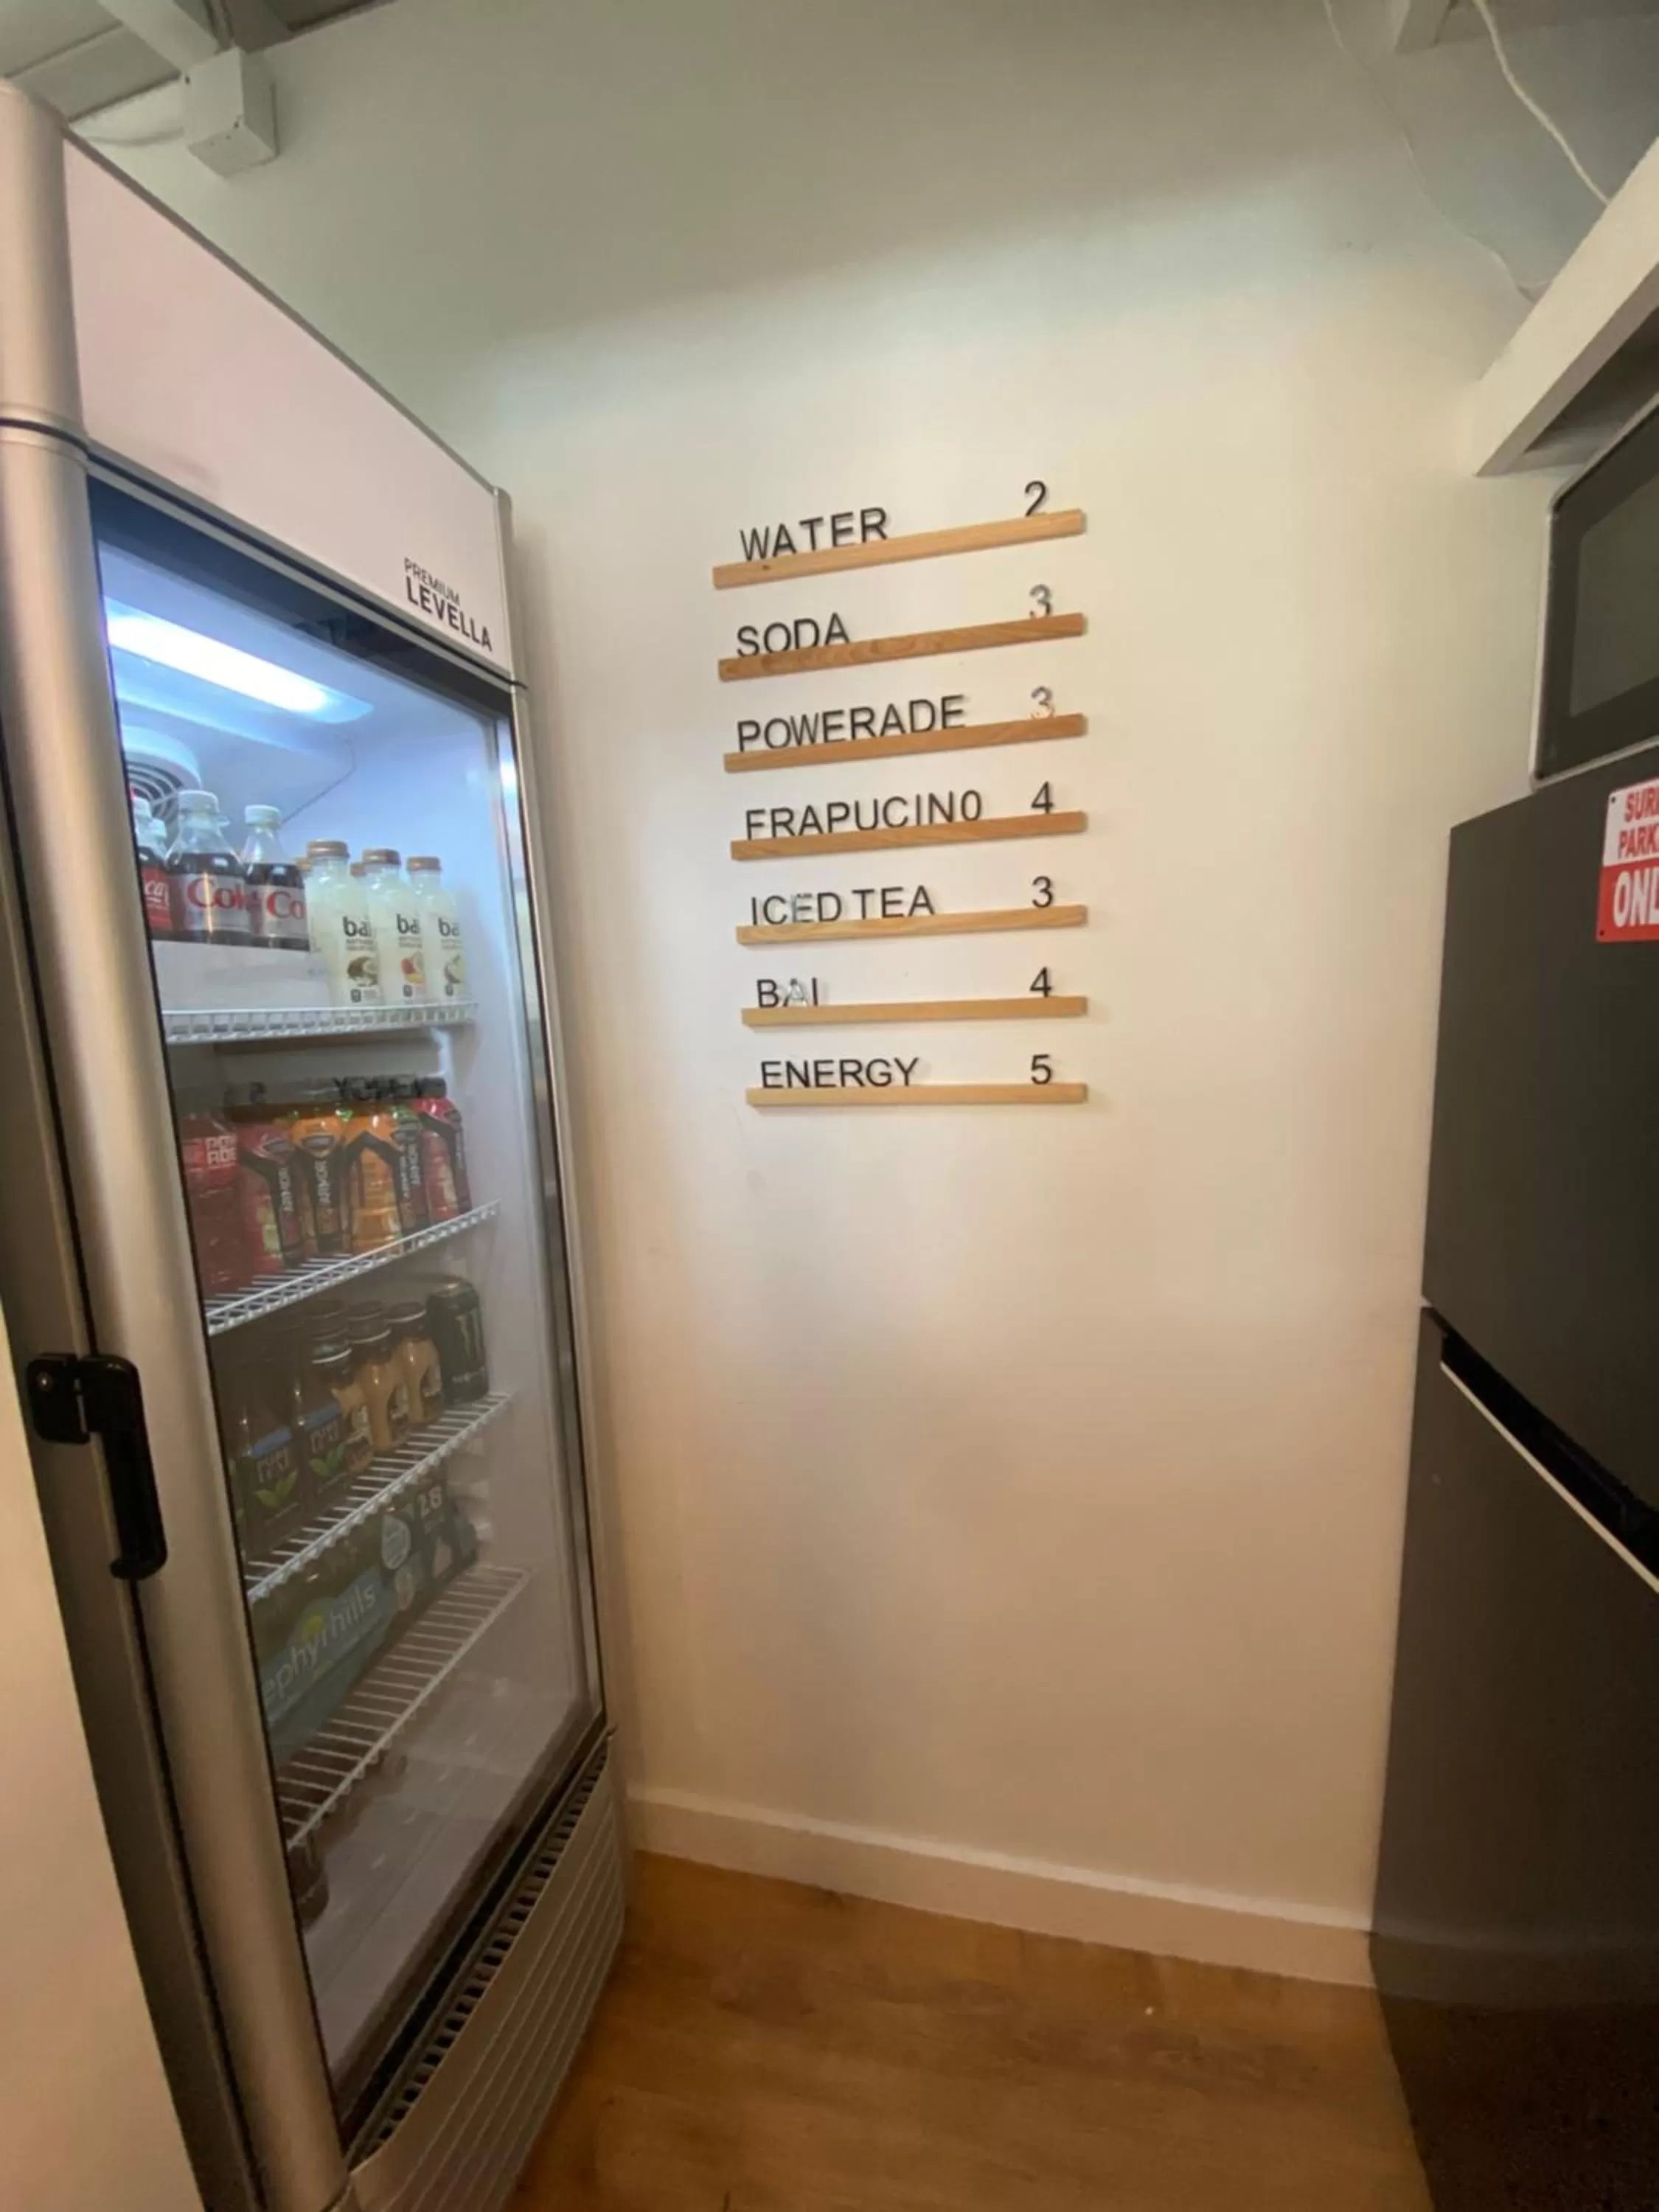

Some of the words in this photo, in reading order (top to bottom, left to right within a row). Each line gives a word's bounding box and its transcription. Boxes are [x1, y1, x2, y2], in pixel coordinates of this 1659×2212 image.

[740, 507, 888, 562] WATER
[1024, 481, 1047, 517] 2
[403, 557, 461, 607] PREMIUM
[406, 574, 493, 652] LEVELLA
[737, 613, 850, 658] SODA
[1029, 585, 1053, 618] 3
[737, 695, 966, 753] POWERADE
[1030, 686, 1055, 719] 3
[1031, 781, 1054, 814] 4
[1625, 787, 1659, 822] SUR
[751, 892, 842, 926] ICED
[852, 886, 936, 920] TEA
[1032, 876, 1054, 908] 3
[757, 977, 818, 1009] BAI
[1029, 967, 1053, 998] 4
[761, 1057, 919, 1089] ENERGY
[1030, 1054, 1053, 1085] 5
